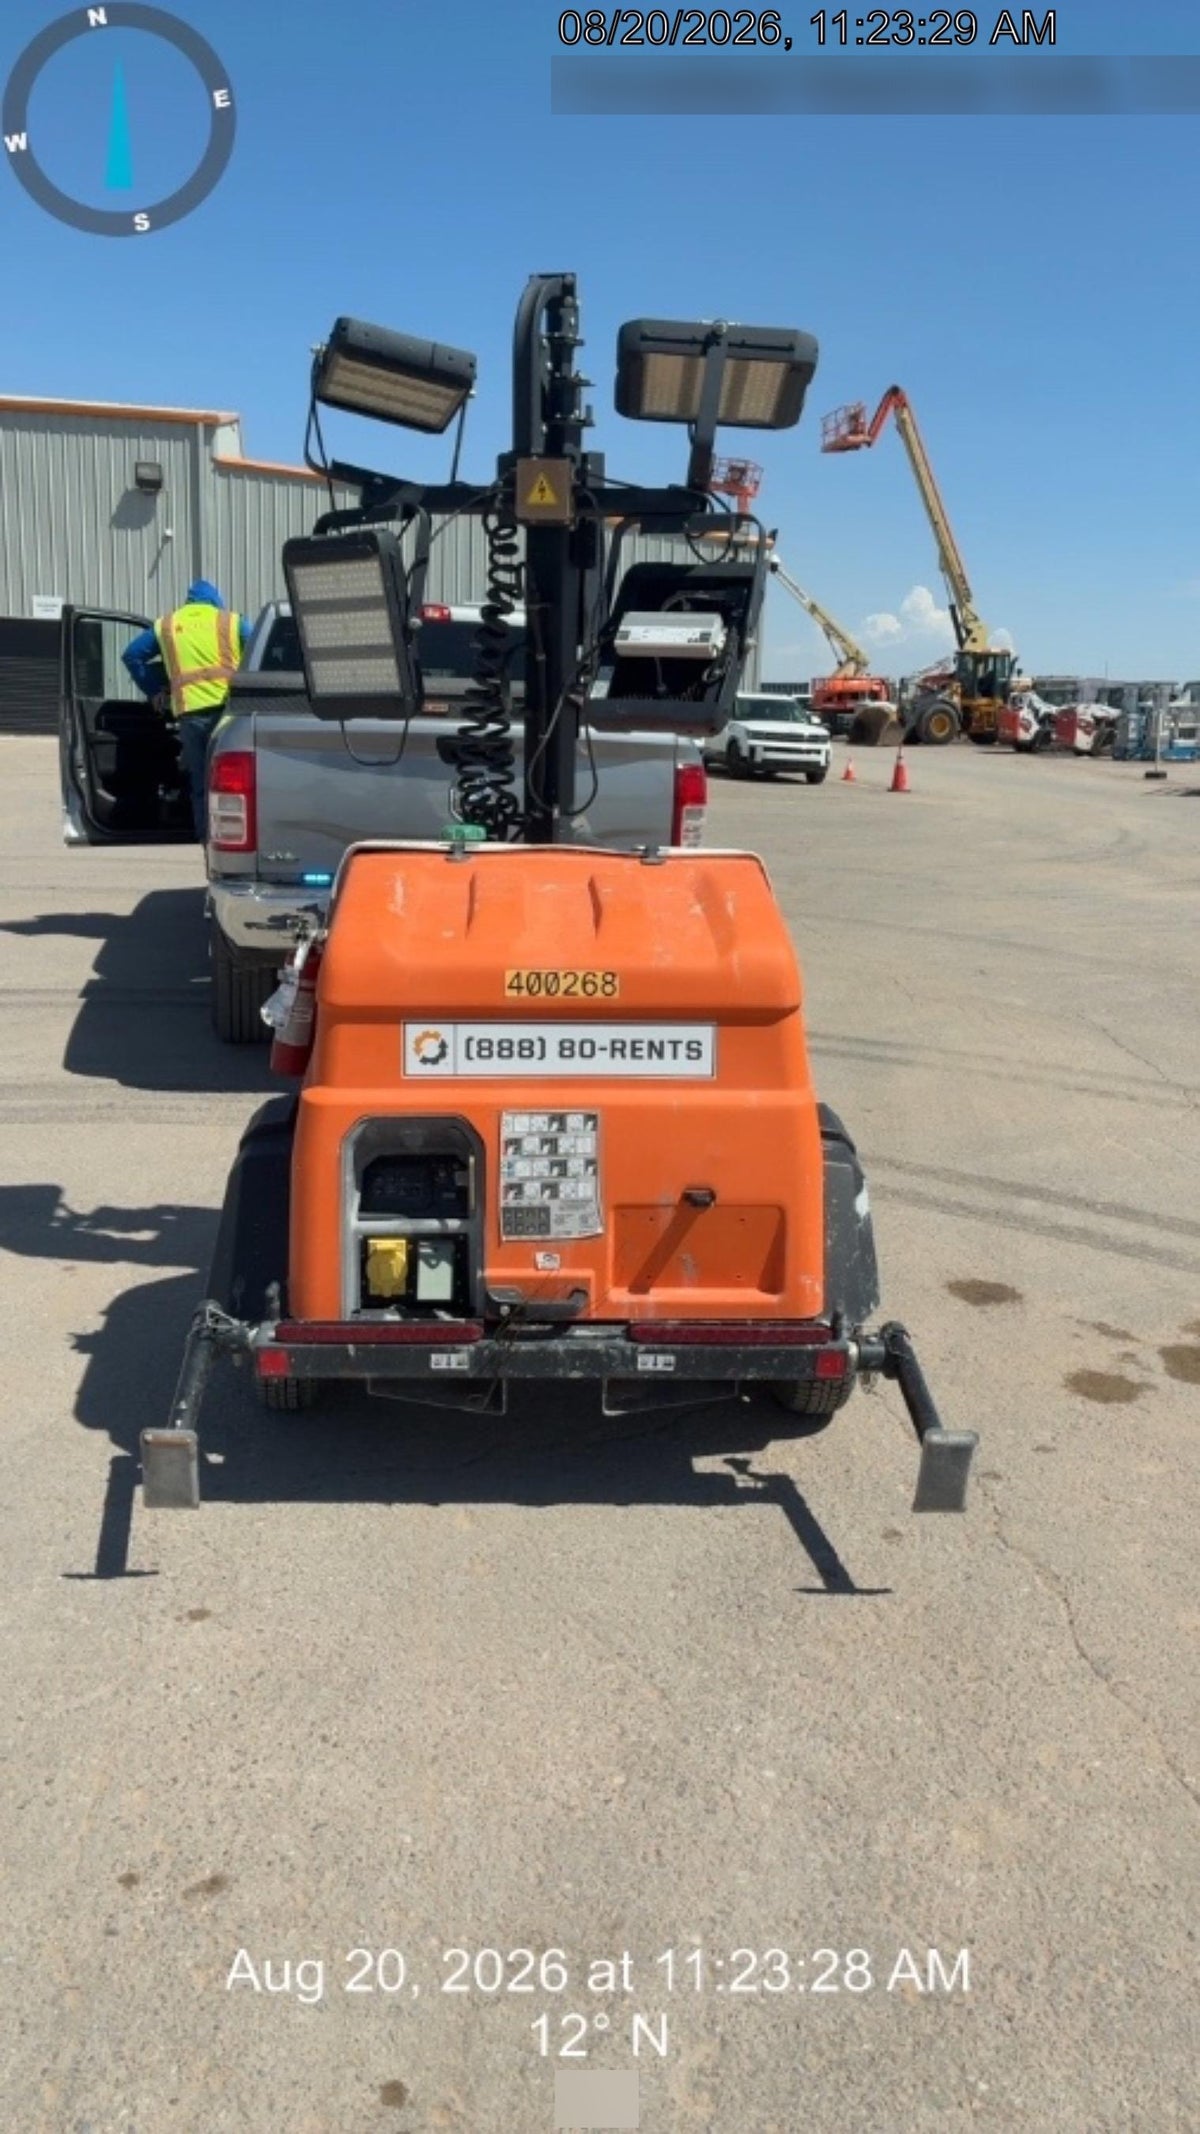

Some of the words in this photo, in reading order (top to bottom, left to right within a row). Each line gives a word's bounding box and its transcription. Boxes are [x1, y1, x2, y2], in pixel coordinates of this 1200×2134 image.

[506, 971, 617, 996] 400268
[464, 1036, 547, 1062] (888)
[557, 1038, 703, 1061] 80-RENTS
